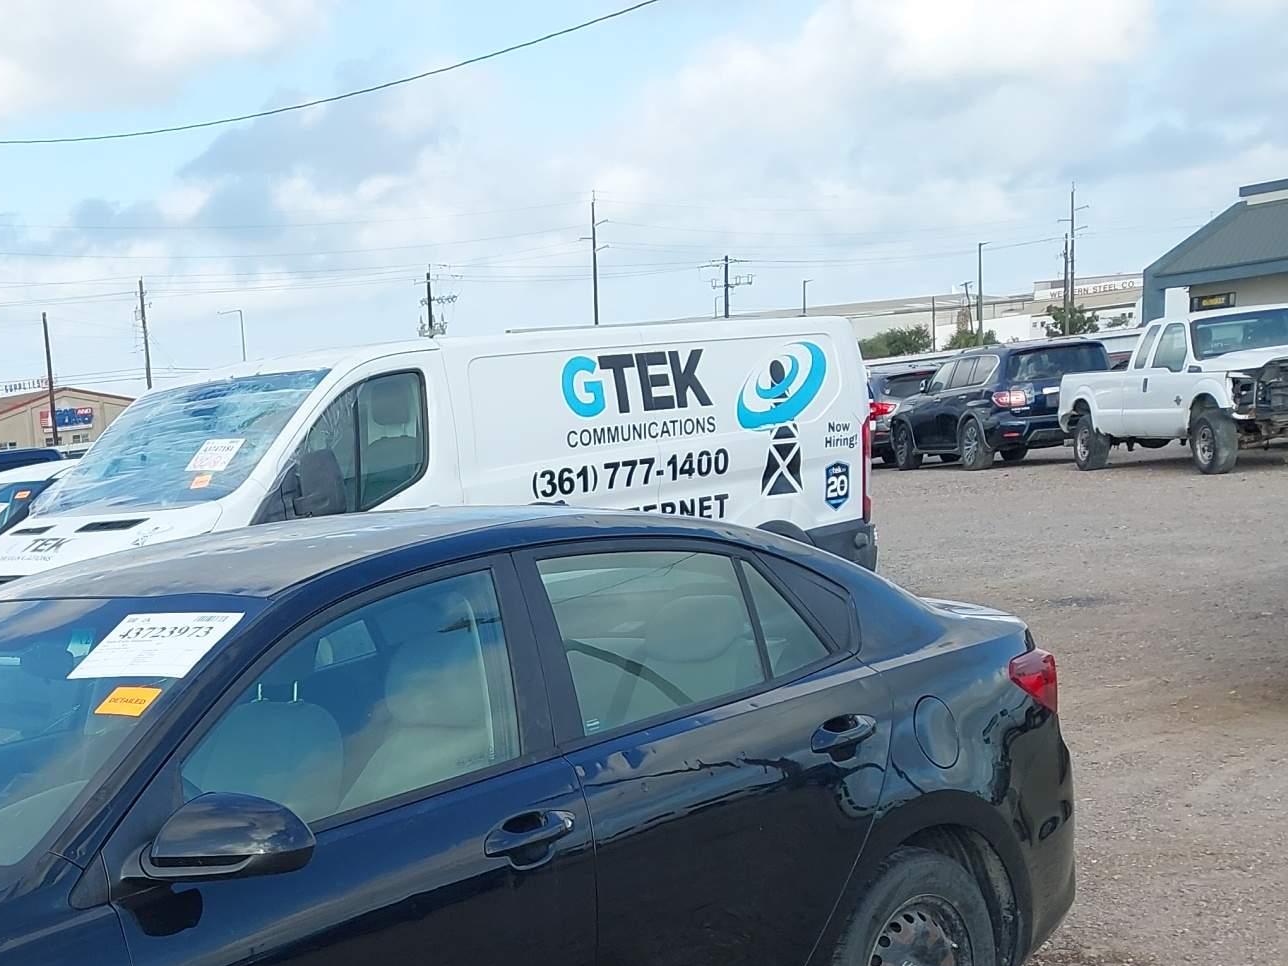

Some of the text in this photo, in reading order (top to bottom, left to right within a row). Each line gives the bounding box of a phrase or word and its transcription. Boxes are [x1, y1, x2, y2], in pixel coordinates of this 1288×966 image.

[1050, 287, 1089, 299] WEERN
[1092, 282, 1118, 294] STEEL
[562, 349, 713, 418] GTEK
[567, 416, 716, 448] COMMUNICATIONS
[828, 421, 850, 433] Now
[824, 434, 858, 449] Hiring!
[532, 448, 729, 499] (361) 777-1400
[827, 475, 848, 499] 20
[118, 626, 215, 640] 43723973
[108, 697, 147, 706] DETAILED
